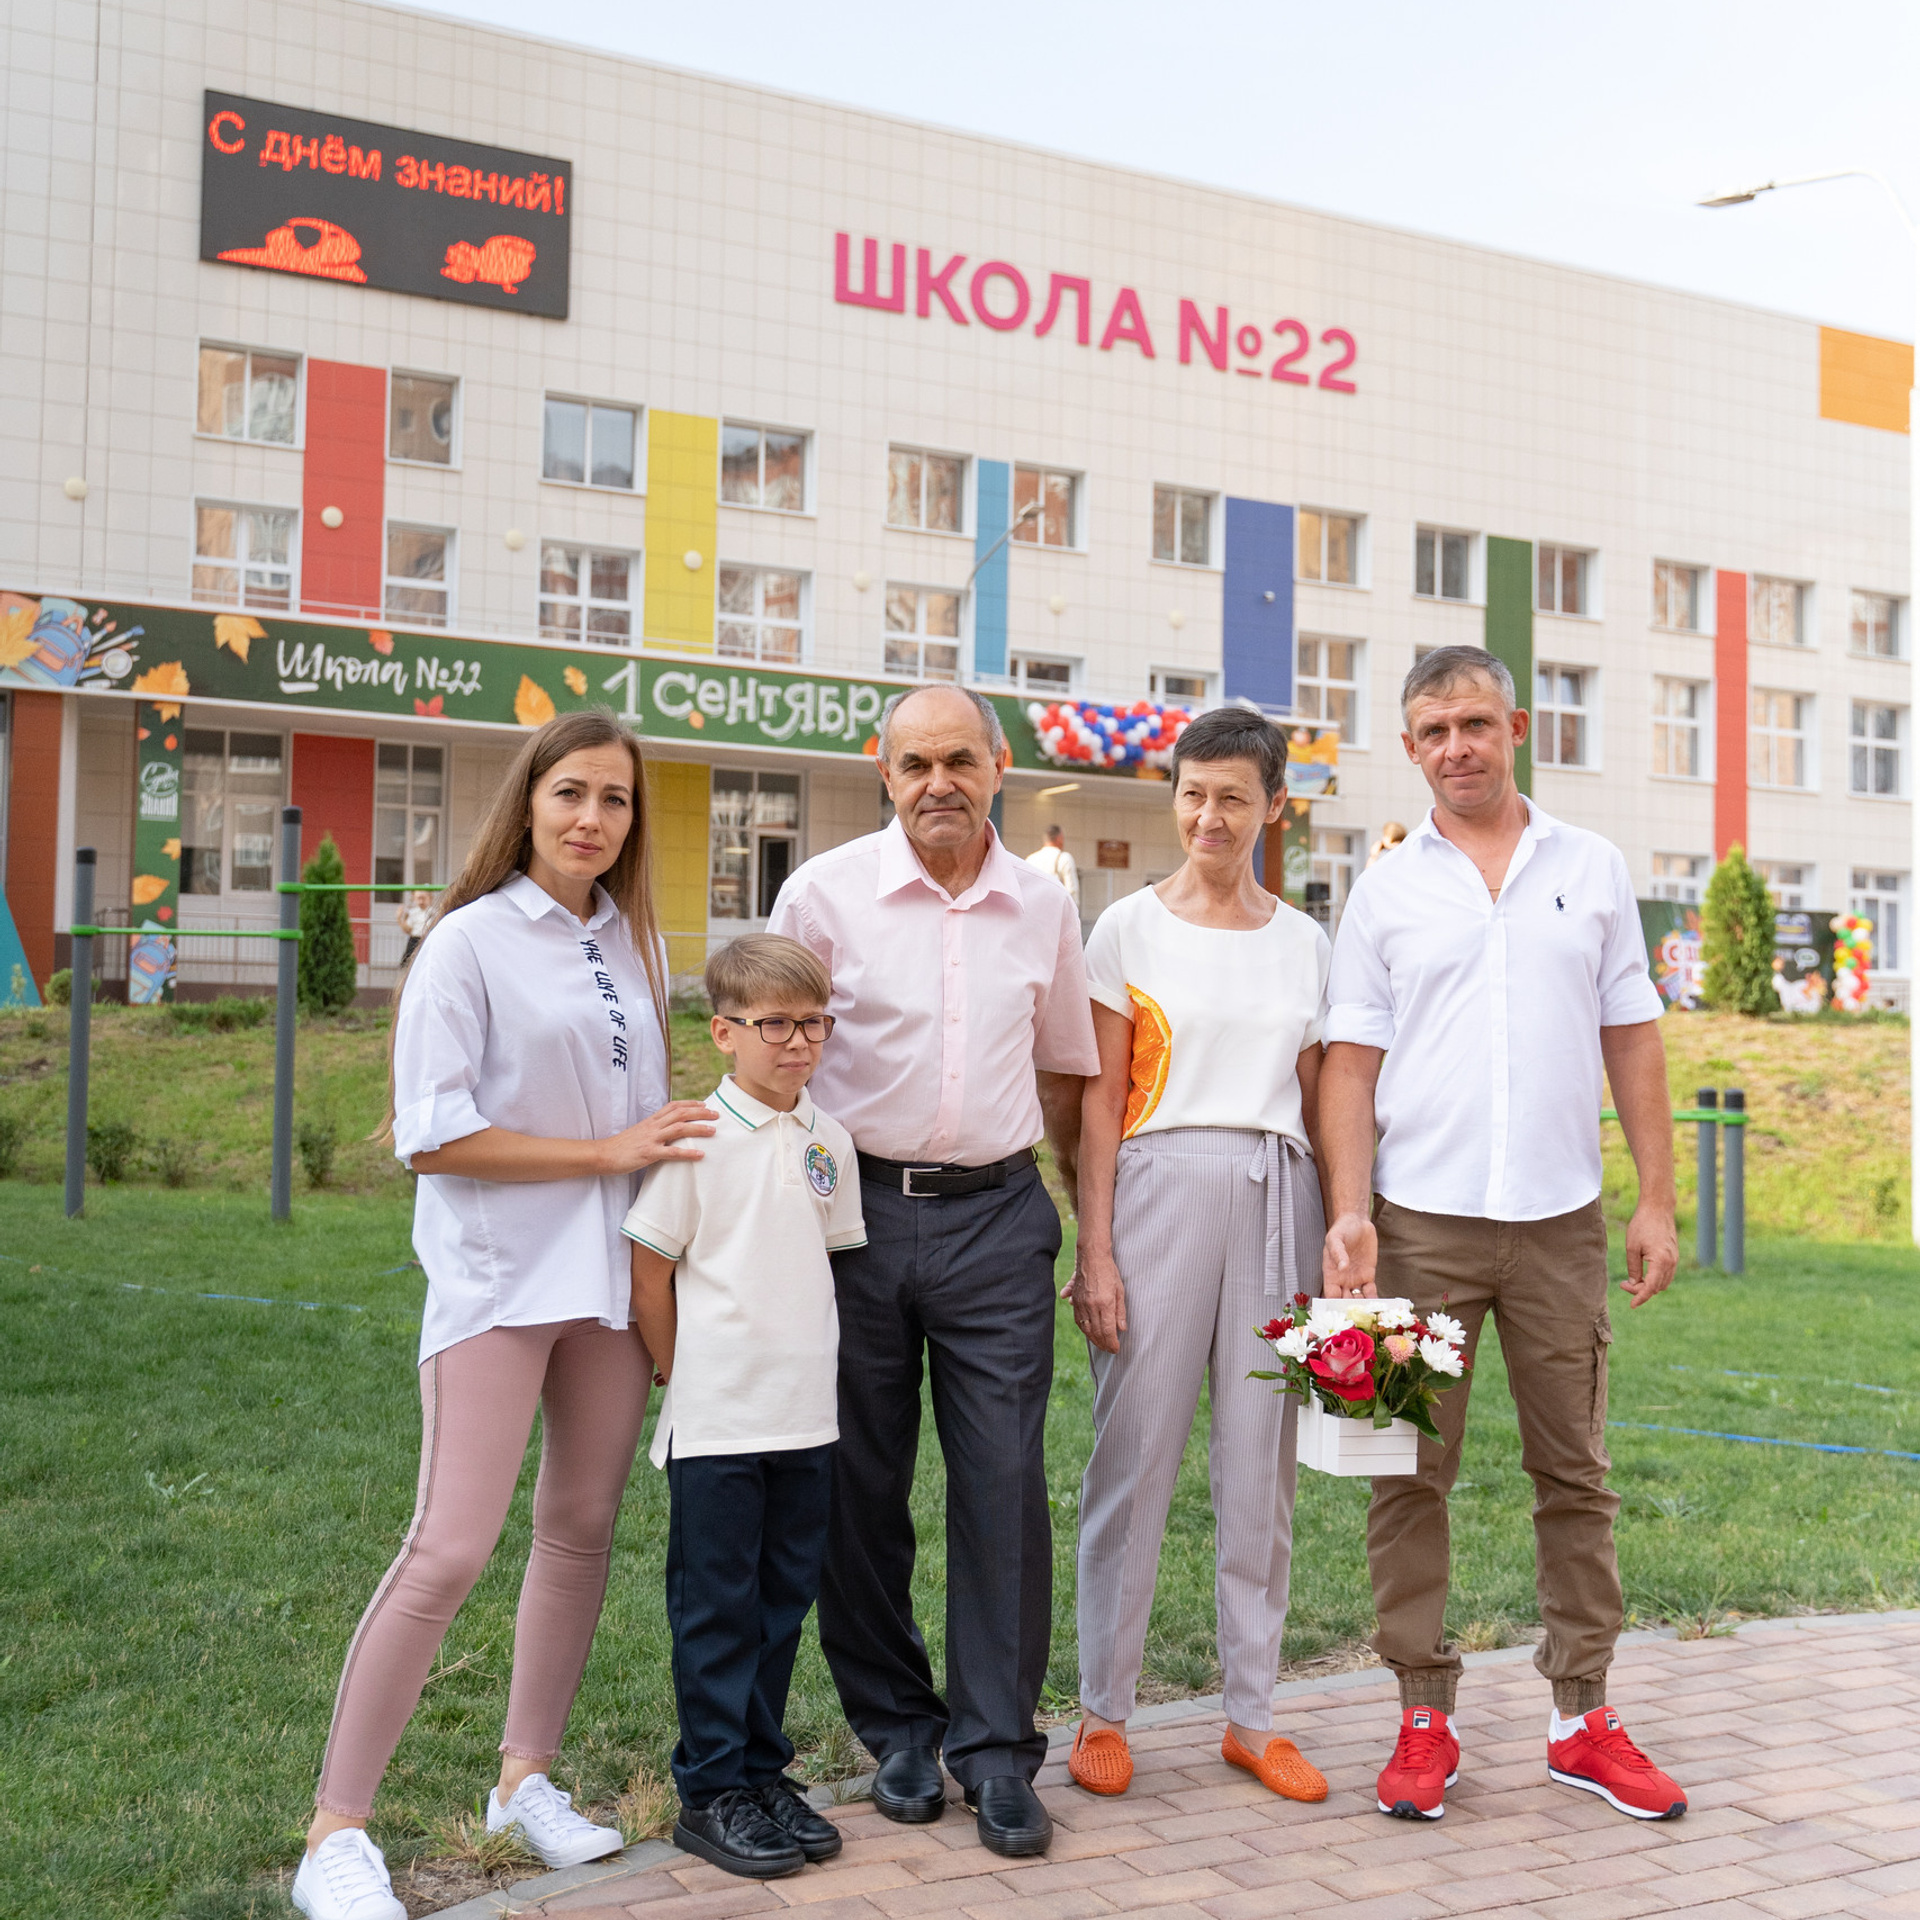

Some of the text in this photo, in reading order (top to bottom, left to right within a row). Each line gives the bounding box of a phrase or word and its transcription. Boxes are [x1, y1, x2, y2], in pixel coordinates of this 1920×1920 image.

[208, 110, 565, 215] С днём знаний!
[834, 231, 1357, 394] ШКОЛА №22
[276, 639, 409, 696] Школа
[601, 659, 903, 742] 1 Сентябр
[609, 1009, 626, 1032] OF
[612, 1035, 628, 1072] LIFE
